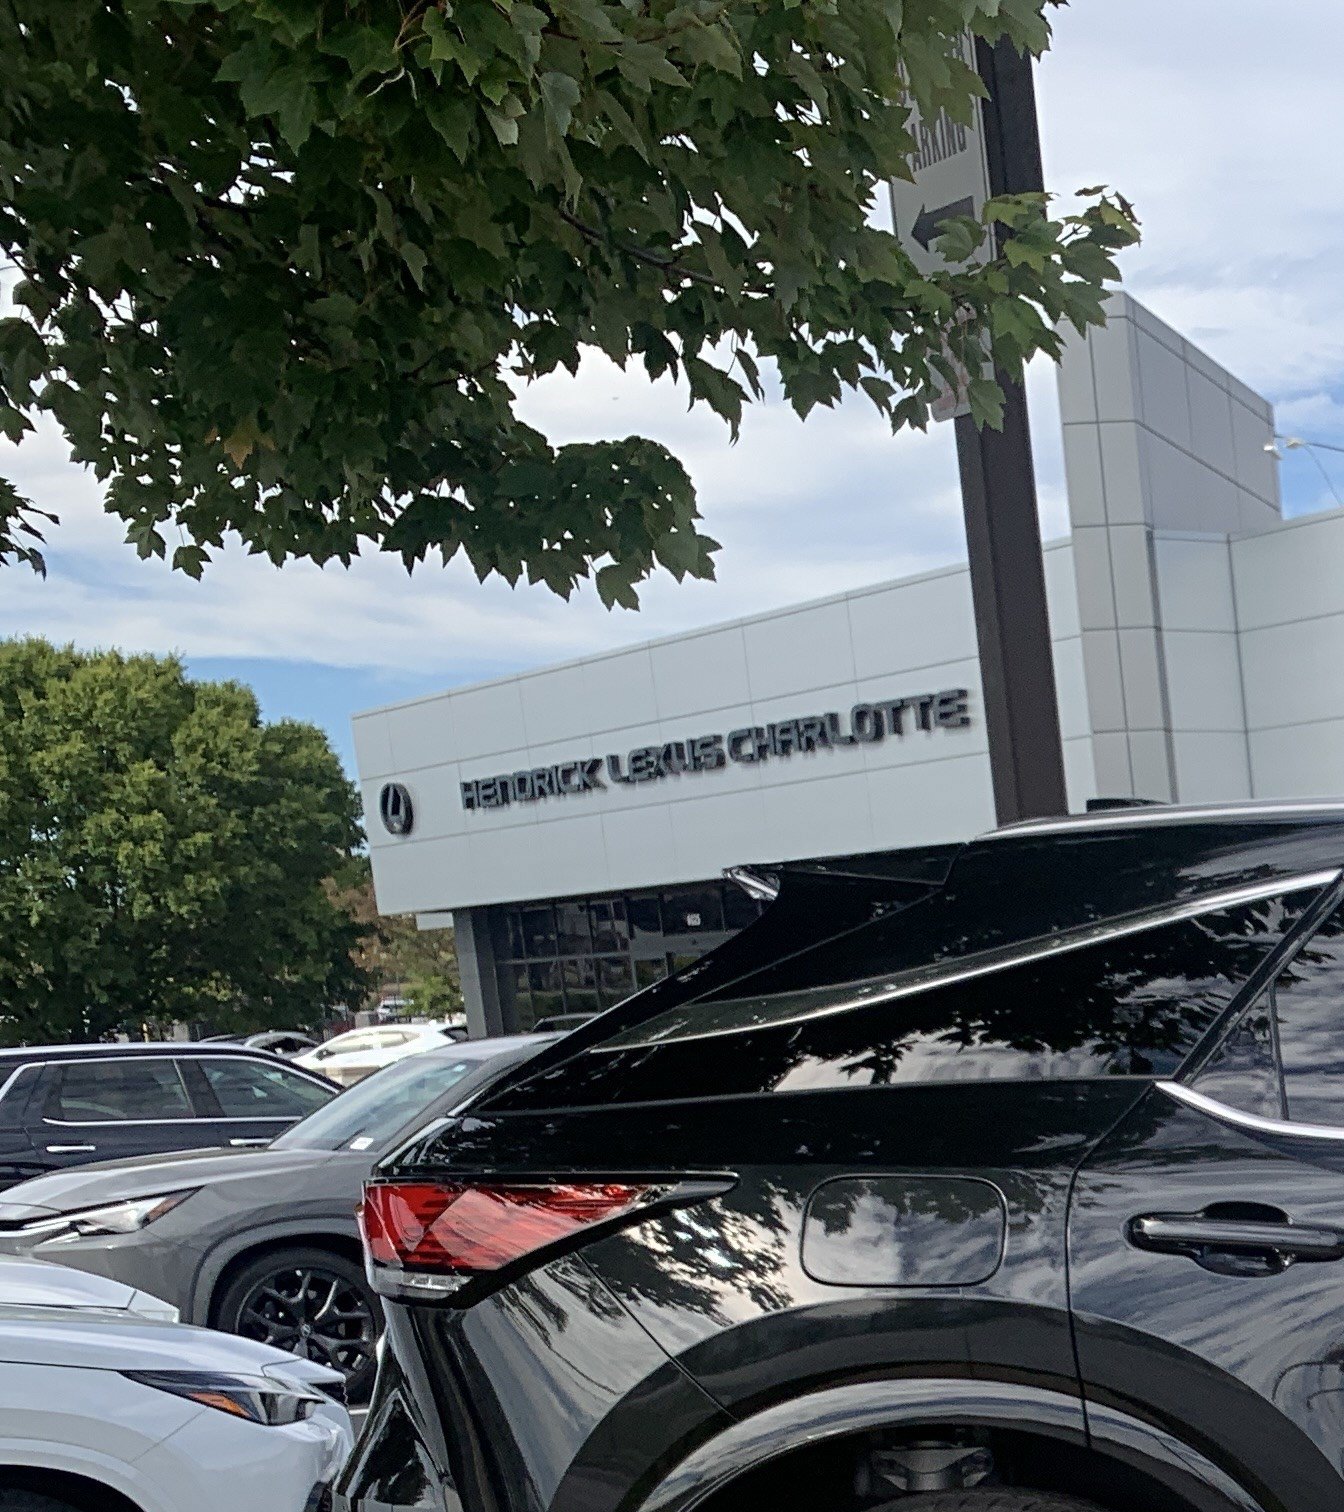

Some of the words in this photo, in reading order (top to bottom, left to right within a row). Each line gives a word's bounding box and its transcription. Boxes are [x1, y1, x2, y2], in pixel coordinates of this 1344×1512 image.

[460, 757, 607, 810] HENDRICK
[607, 733, 727, 784] LEXUS
[728, 688, 971, 764] CHARLOTTE
